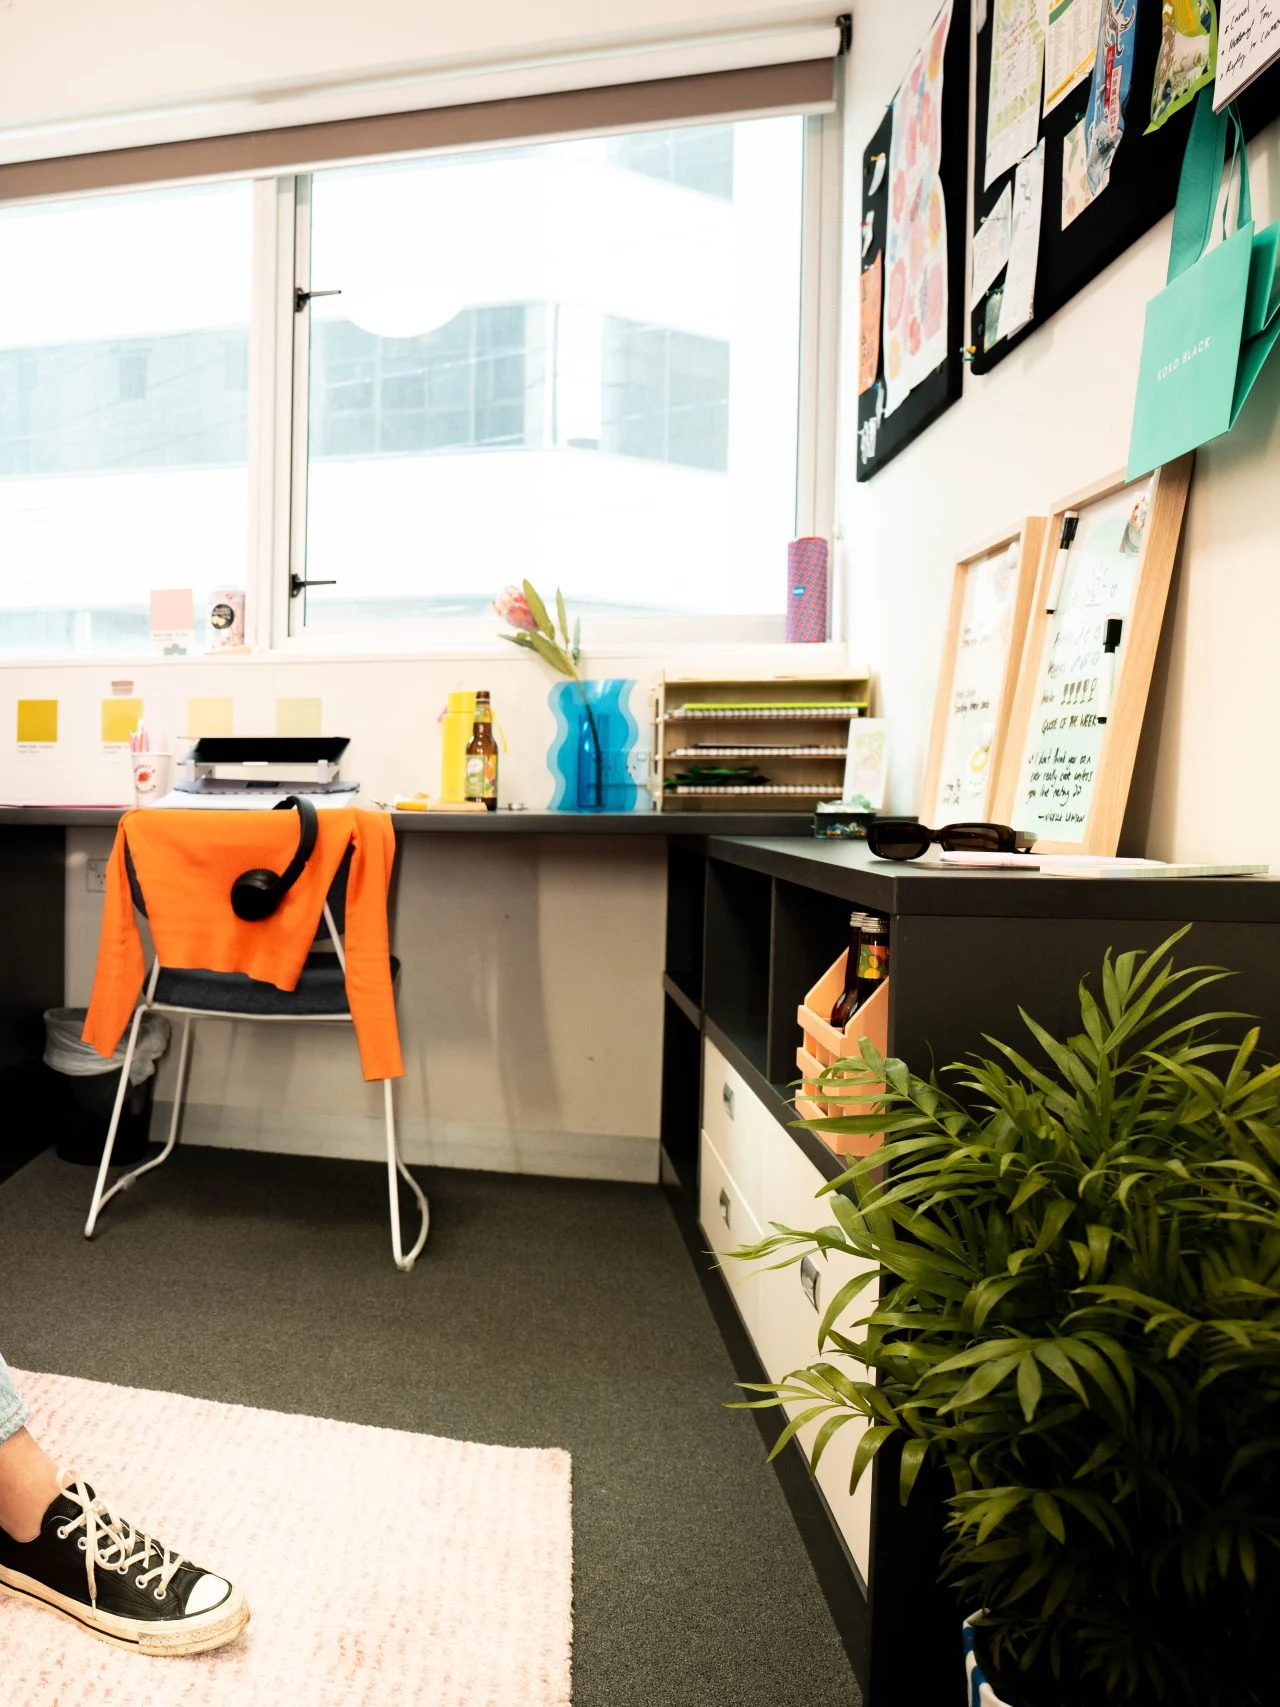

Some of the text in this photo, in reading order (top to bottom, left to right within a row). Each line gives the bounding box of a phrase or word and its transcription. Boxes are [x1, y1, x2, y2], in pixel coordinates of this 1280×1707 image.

[1157, 335, 1212, 382] KOKO BLACK
[1080, 713, 1097, 728] WEEK
